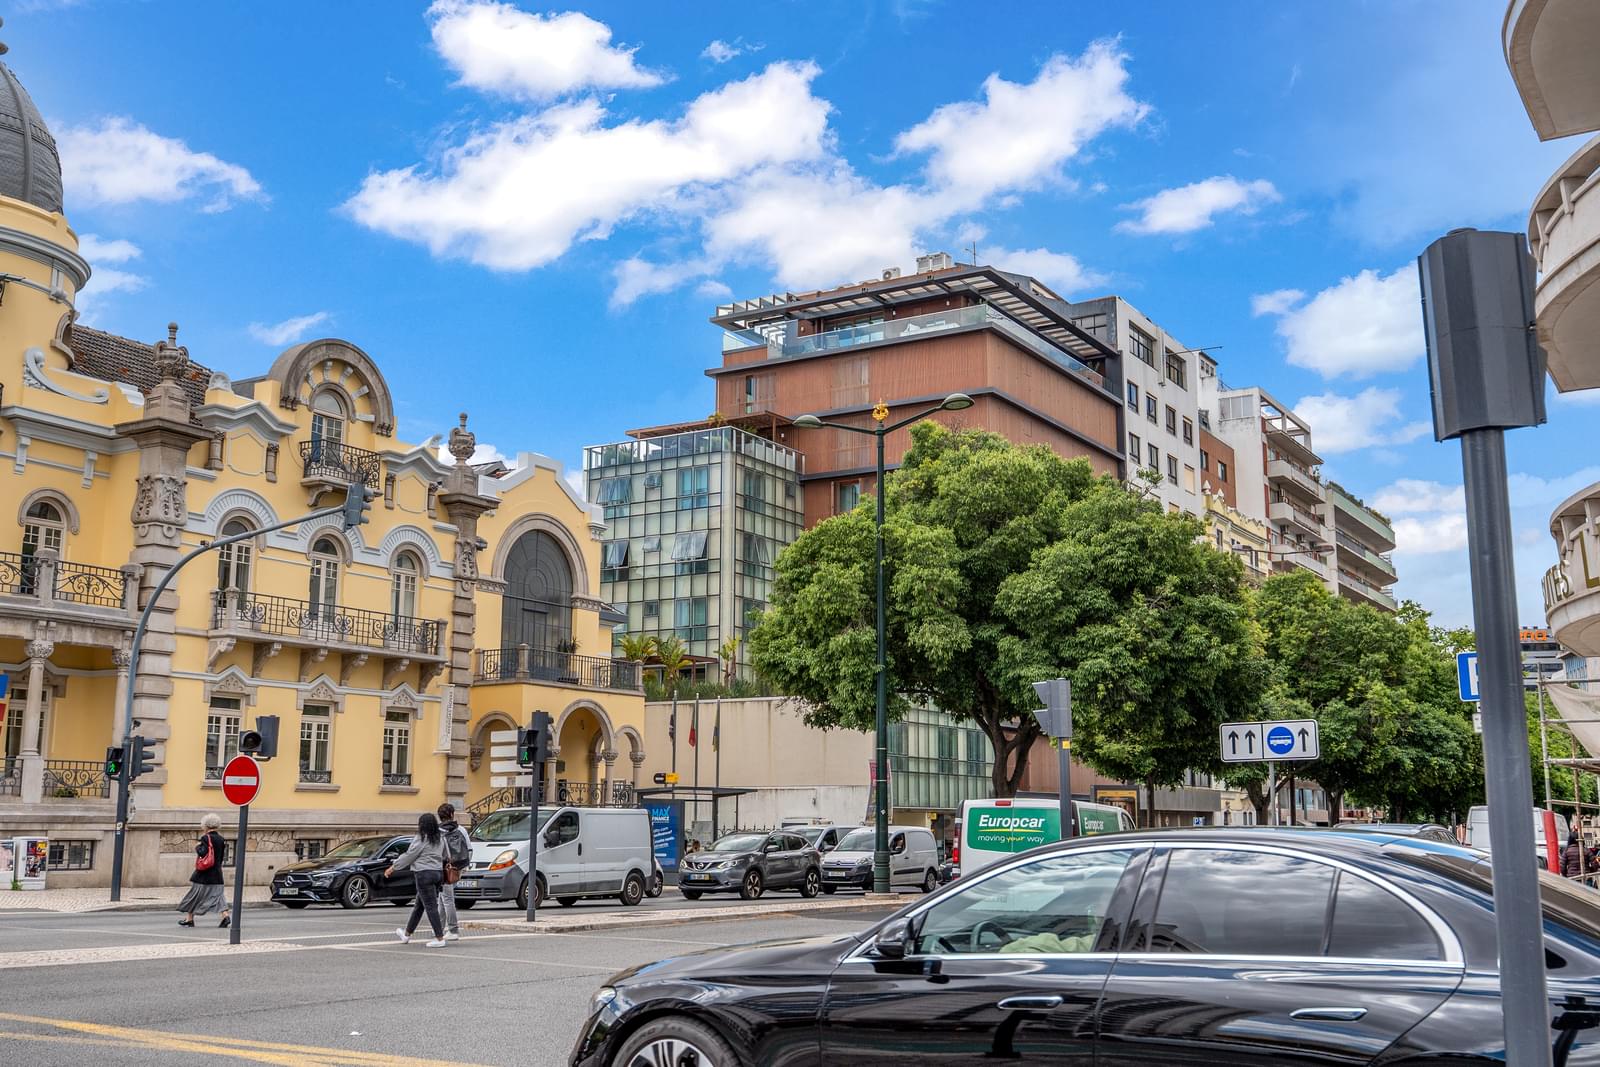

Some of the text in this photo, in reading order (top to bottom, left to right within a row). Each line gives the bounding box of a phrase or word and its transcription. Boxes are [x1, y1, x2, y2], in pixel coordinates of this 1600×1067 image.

[651, 807, 670, 817] MAX
[978, 814, 1046, 831] Europcar
[1084, 817, 1104, 833] Europcar
[977, 835, 1045, 844] moving your way
